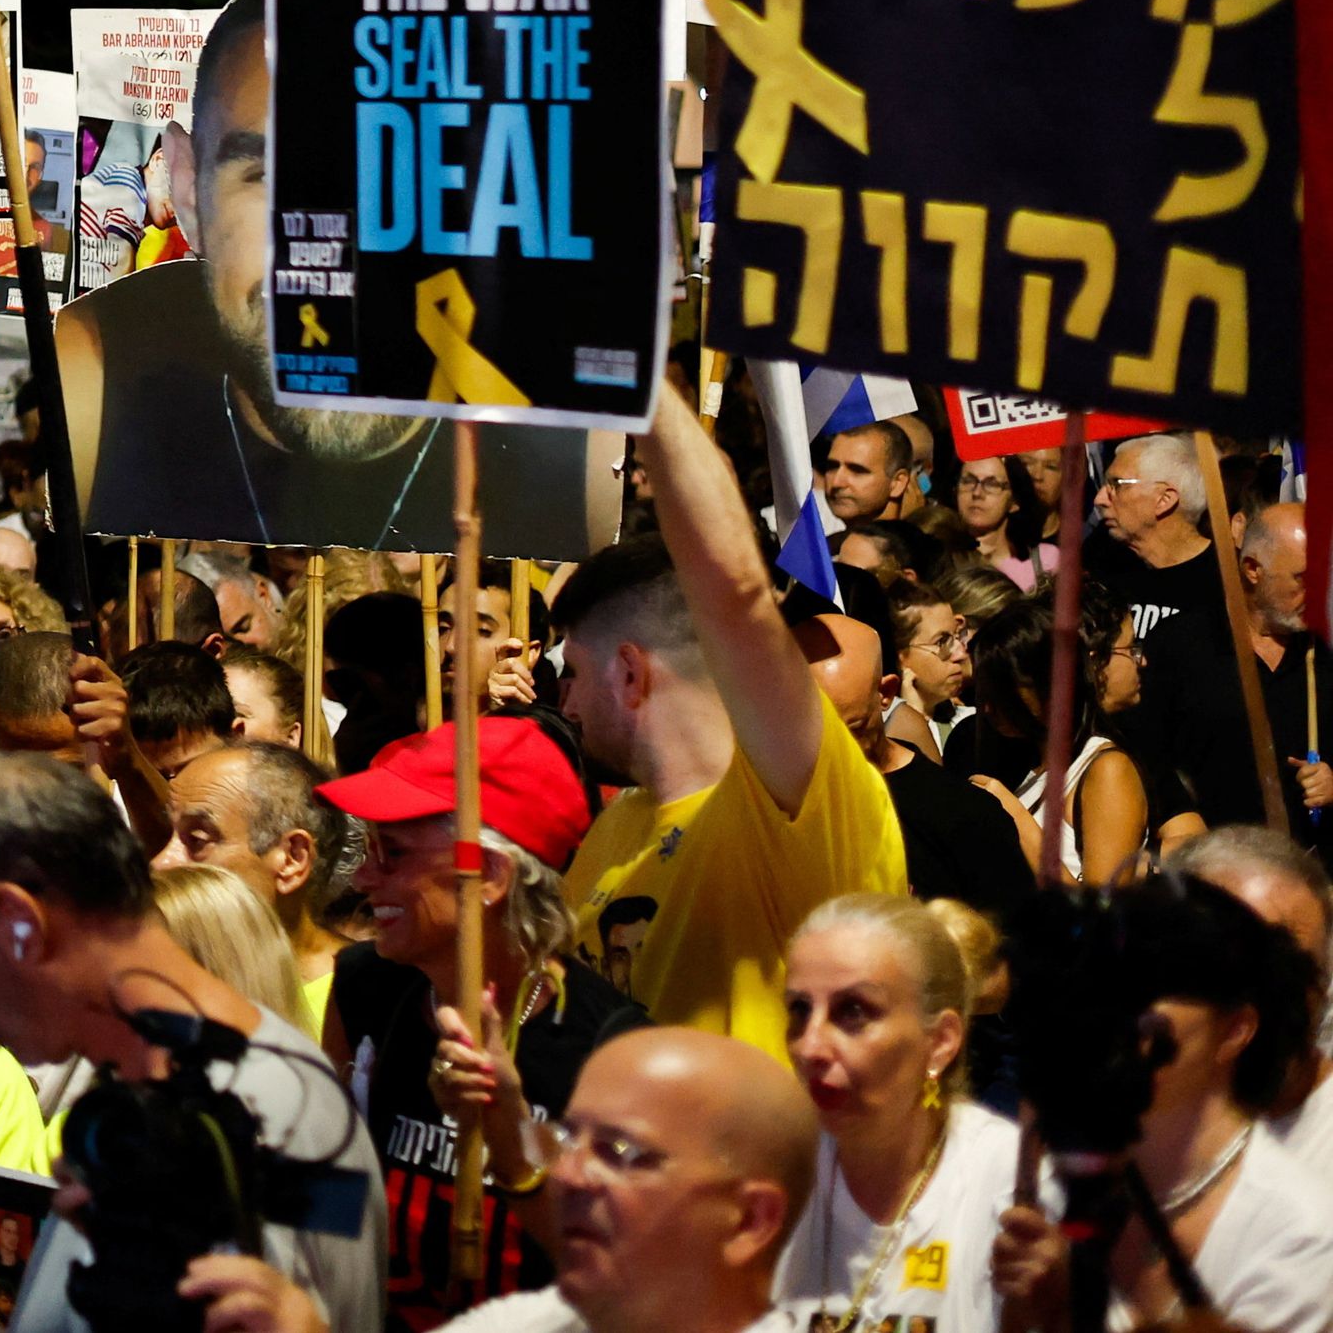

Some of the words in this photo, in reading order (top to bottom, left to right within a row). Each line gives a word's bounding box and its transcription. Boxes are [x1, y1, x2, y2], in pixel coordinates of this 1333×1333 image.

[103, 33, 122, 47] BAR
[124, 33, 170, 48] ABRAHAM
[353, 16, 482, 100] SEAL
[495, 16, 591, 100] THE
[123, 81, 152, 100] MAKSYM
[155, 85, 188, 103] HARKIN
[133, 102, 151, 117] (36)
[355, 101, 594, 261] DEAL
[80, 236, 120, 267] BRING
[737, 180, 1249, 396] תקווה
